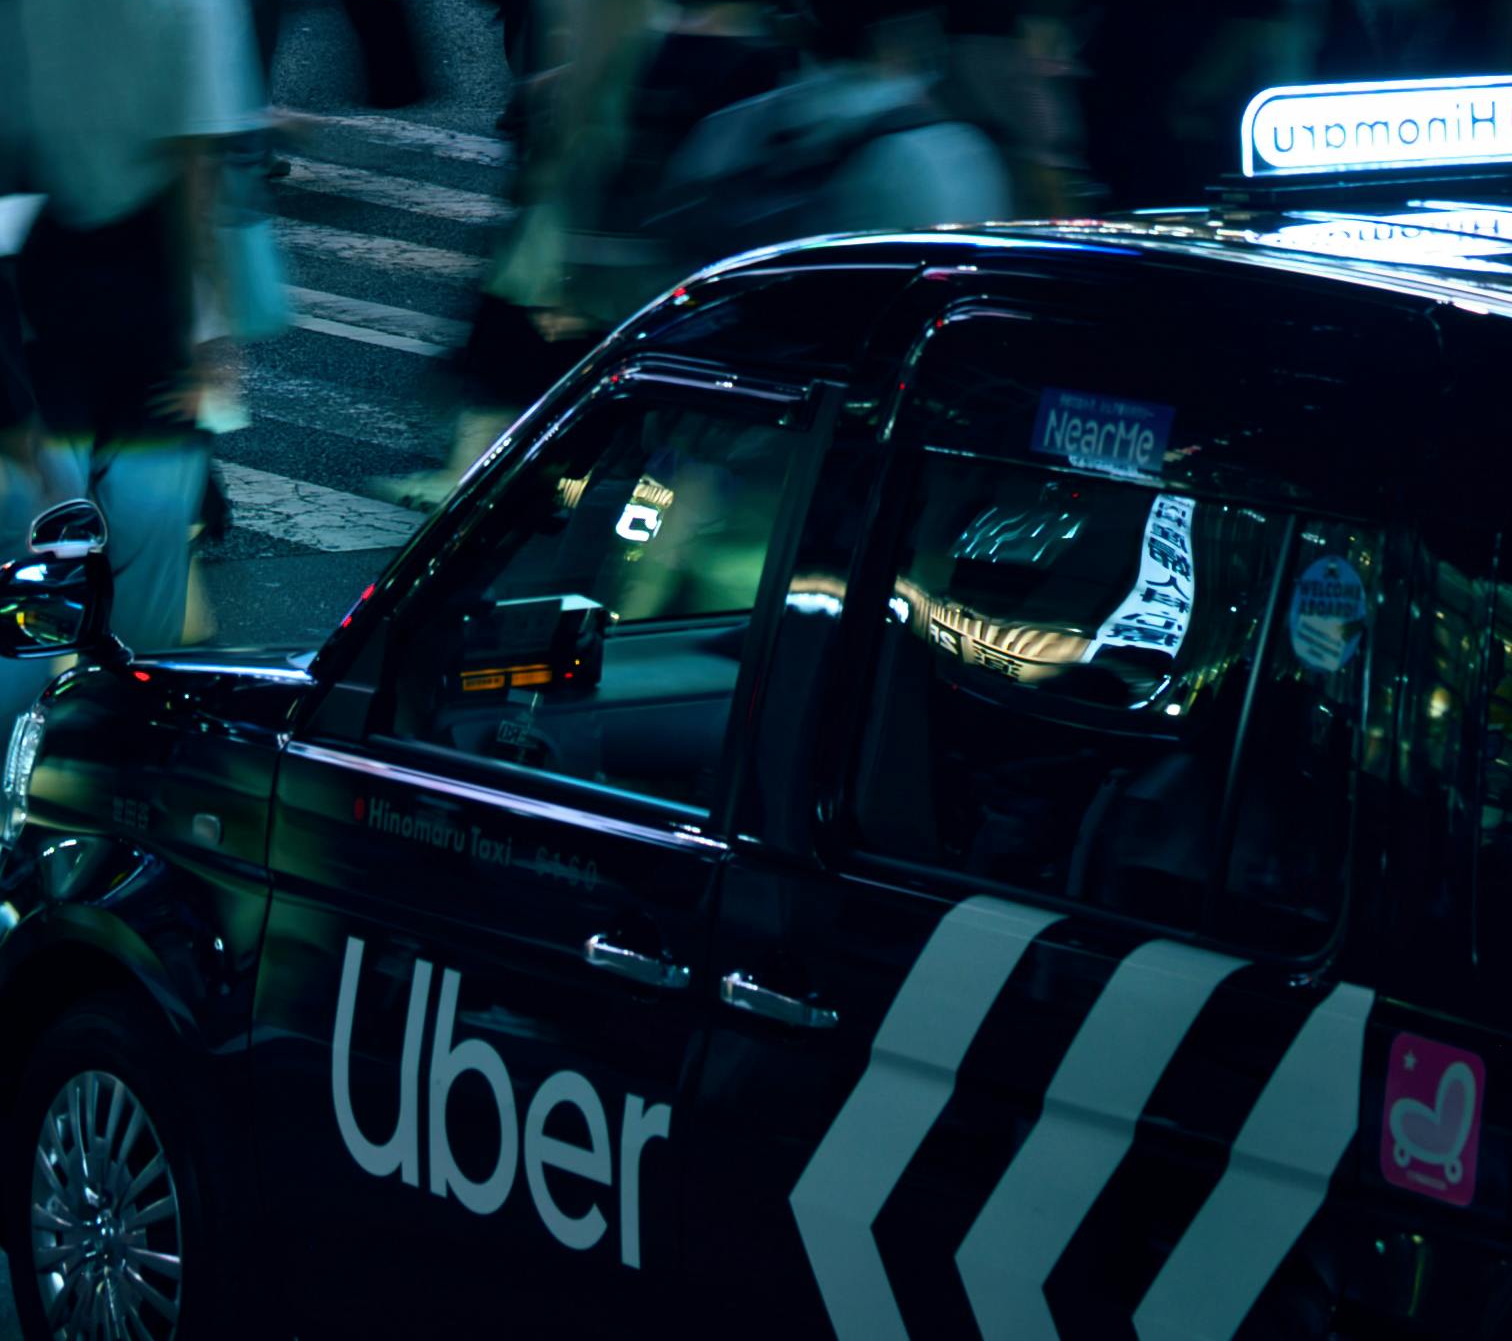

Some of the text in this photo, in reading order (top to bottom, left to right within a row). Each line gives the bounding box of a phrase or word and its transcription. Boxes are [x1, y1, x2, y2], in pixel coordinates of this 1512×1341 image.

[1043, 408, 1155, 469] NearMe
[368, 796, 466, 855] Hinomaru
[470, 827, 513, 868] Taxi
[329, 935, 673, 1268] Uber
